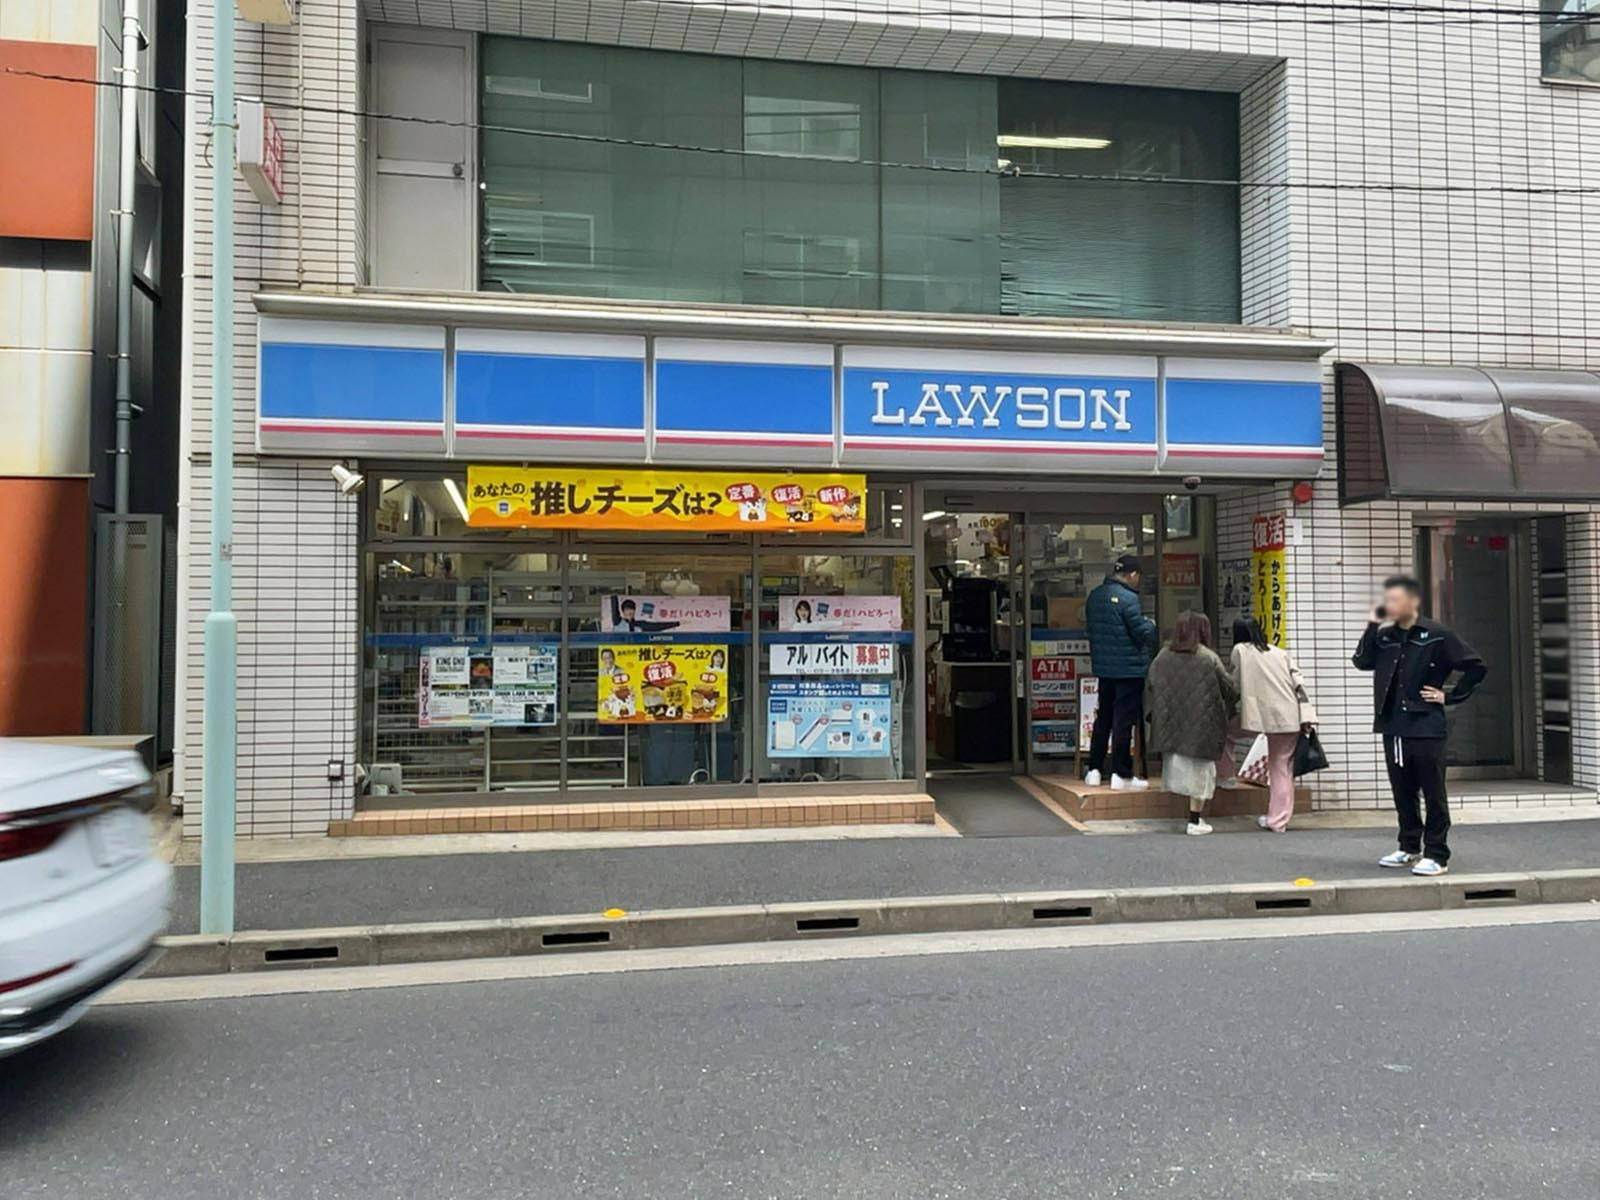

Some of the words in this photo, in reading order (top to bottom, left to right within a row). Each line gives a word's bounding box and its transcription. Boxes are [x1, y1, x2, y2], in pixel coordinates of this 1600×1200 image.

[872, 382, 1131, 431] LAWSON
[473, 482, 526, 498] あなたの
[530, 481, 722, 516] 推しチーズは?
[728, 484, 755, 500] 定番
[773, 486, 802, 501] 復活
[819, 487, 847, 502] 新作
[1254, 516, 1284, 548] 復活
[1037, 660, 1069, 672] ATM
